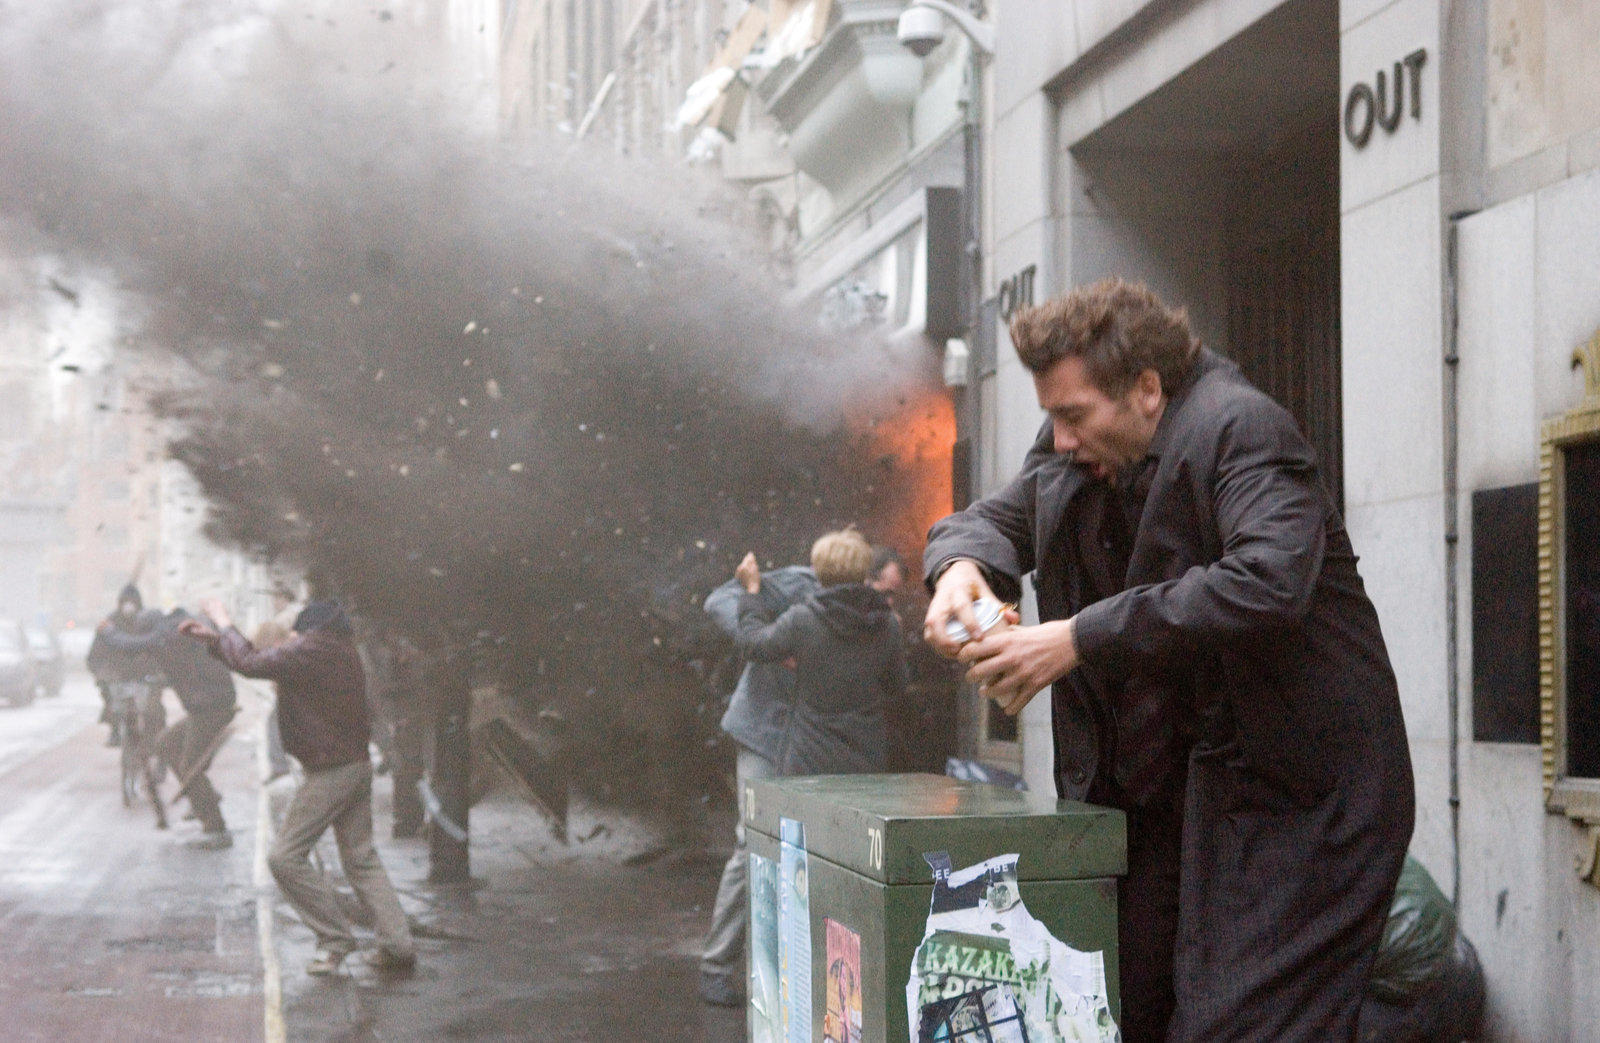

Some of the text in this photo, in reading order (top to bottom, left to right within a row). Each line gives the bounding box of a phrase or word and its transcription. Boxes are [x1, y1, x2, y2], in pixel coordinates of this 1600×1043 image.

[1344, 48, 1427, 150] OUT
[999, 264, 1036, 324] OUT
[868, 828, 882, 870] 70
